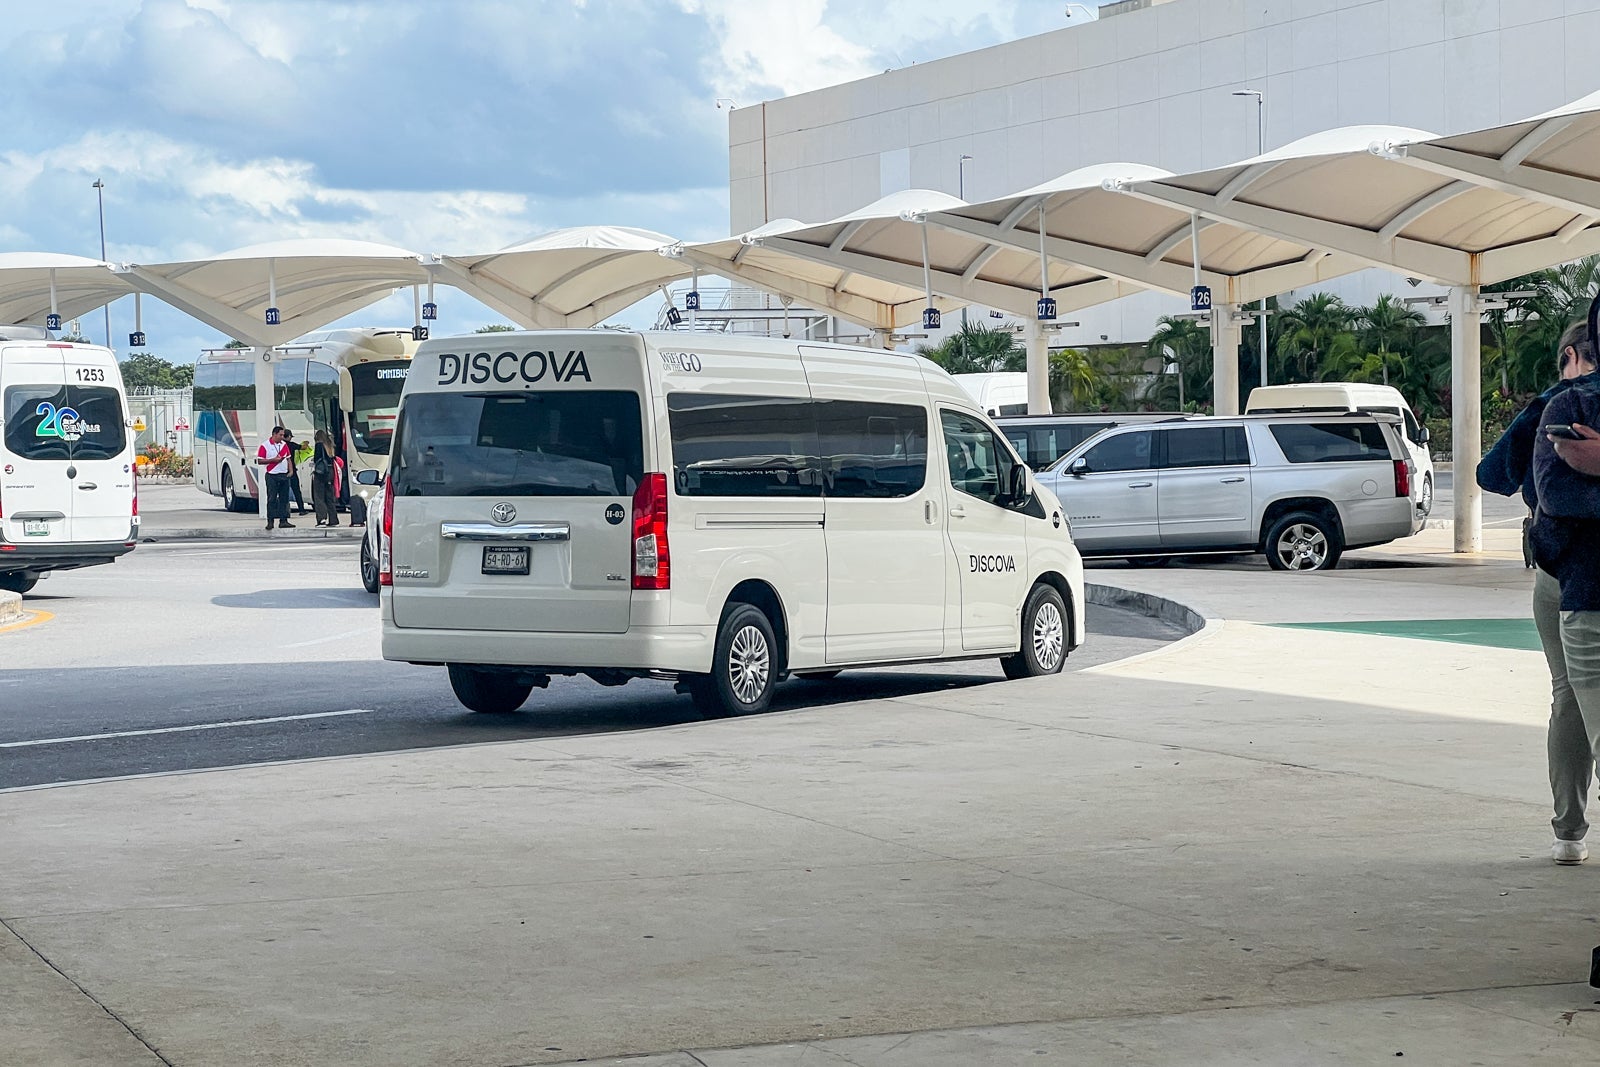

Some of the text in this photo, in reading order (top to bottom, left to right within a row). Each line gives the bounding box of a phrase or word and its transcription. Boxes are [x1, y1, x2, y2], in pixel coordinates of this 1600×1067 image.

[686, 296, 697, 307] 29
[1197, 291, 1210, 306] 26
[423, 307, 431, 317] 30
[668, 309, 678, 320] 11
[1047, 303, 1056, 316] 27
[47, 317, 56, 328] 32
[267, 311, 276, 322] 31
[930, 313, 940, 325] 28
[438, 350, 592, 386] DISCOVA
[680, 353, 701, 372] GO
[75, 368, 105, 382] 1253
[969, 555, 1016, 573] DISCOVA
